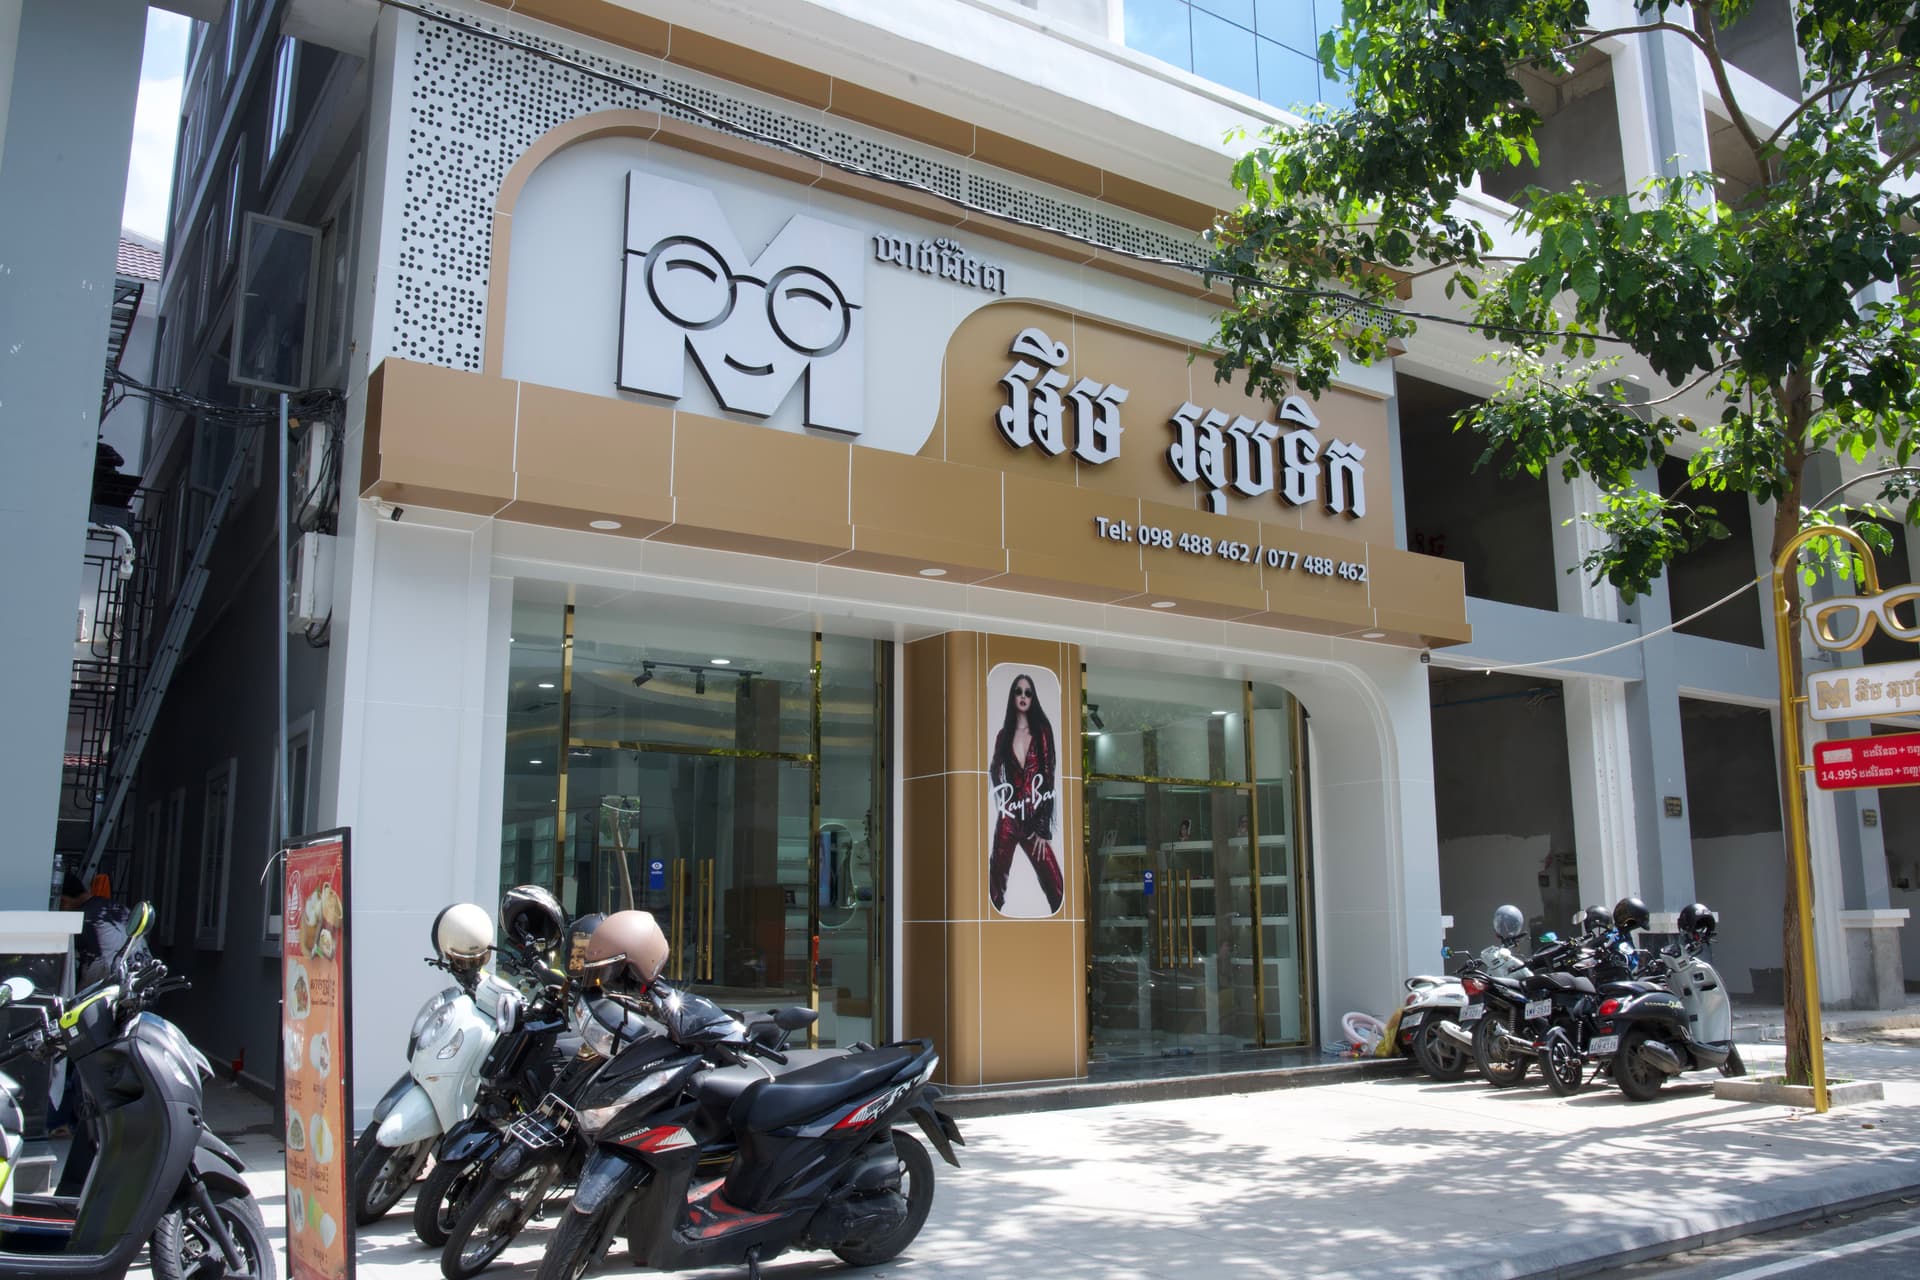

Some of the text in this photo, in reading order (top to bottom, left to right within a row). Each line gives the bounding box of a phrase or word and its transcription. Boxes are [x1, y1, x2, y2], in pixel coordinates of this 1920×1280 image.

[617, 169, 865, 436] M
[1095, 516, 1132, 543] Tel:
[1137, 525, 1173, 549] 098
[1178, 532, 1212, 556] 488
[1217, 539, 1250, 563] 462
[1267, 549, 1298, 570] 077
[1302, 555, 1333, 577] 488
[1337, 561, 1367, 582] 462
[1821, 768, 1858, 781] 14.99$
[619, 1126, 651, 1141] HONDA
